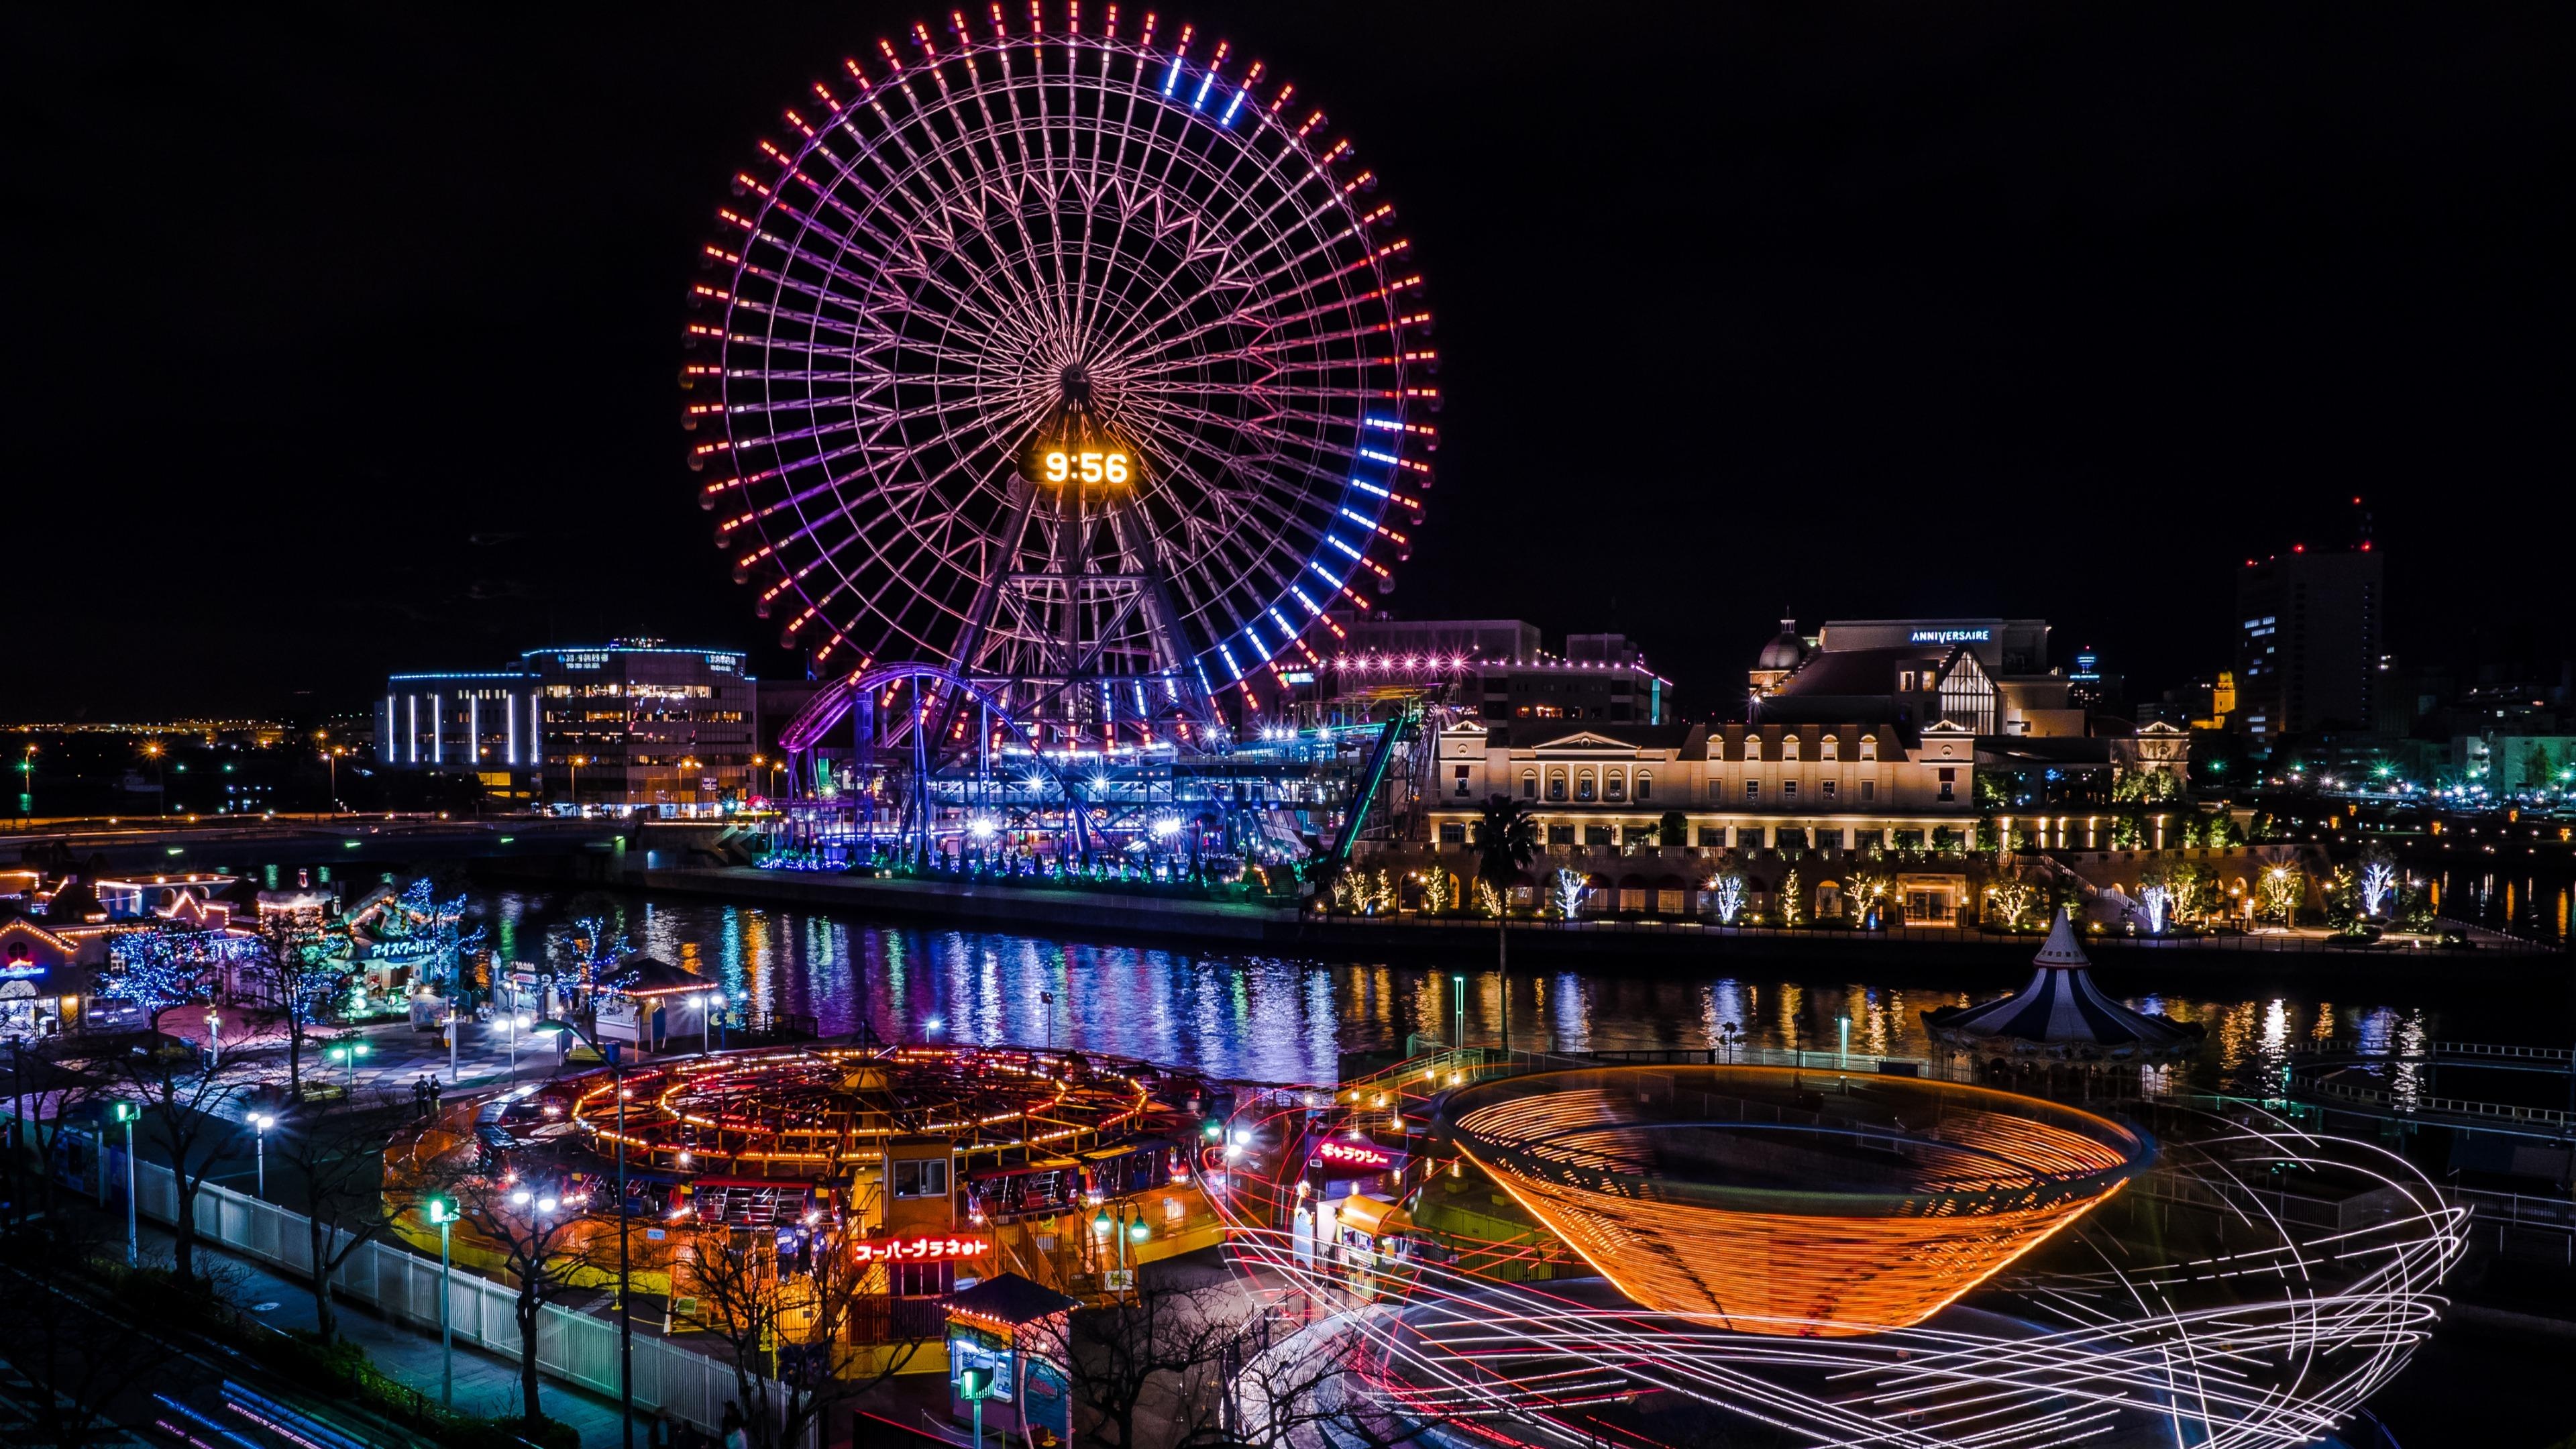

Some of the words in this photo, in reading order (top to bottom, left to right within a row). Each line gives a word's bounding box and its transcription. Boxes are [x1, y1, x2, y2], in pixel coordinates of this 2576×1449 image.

[1046, 451, 1128, 483] 9:56
[1912, 631, 1988, 644] ANNIVERSAIRE
[1321, 1142, 1389, 1164] ギャラクシー
[856, 1238, 988, 1261] スーパープラネット
